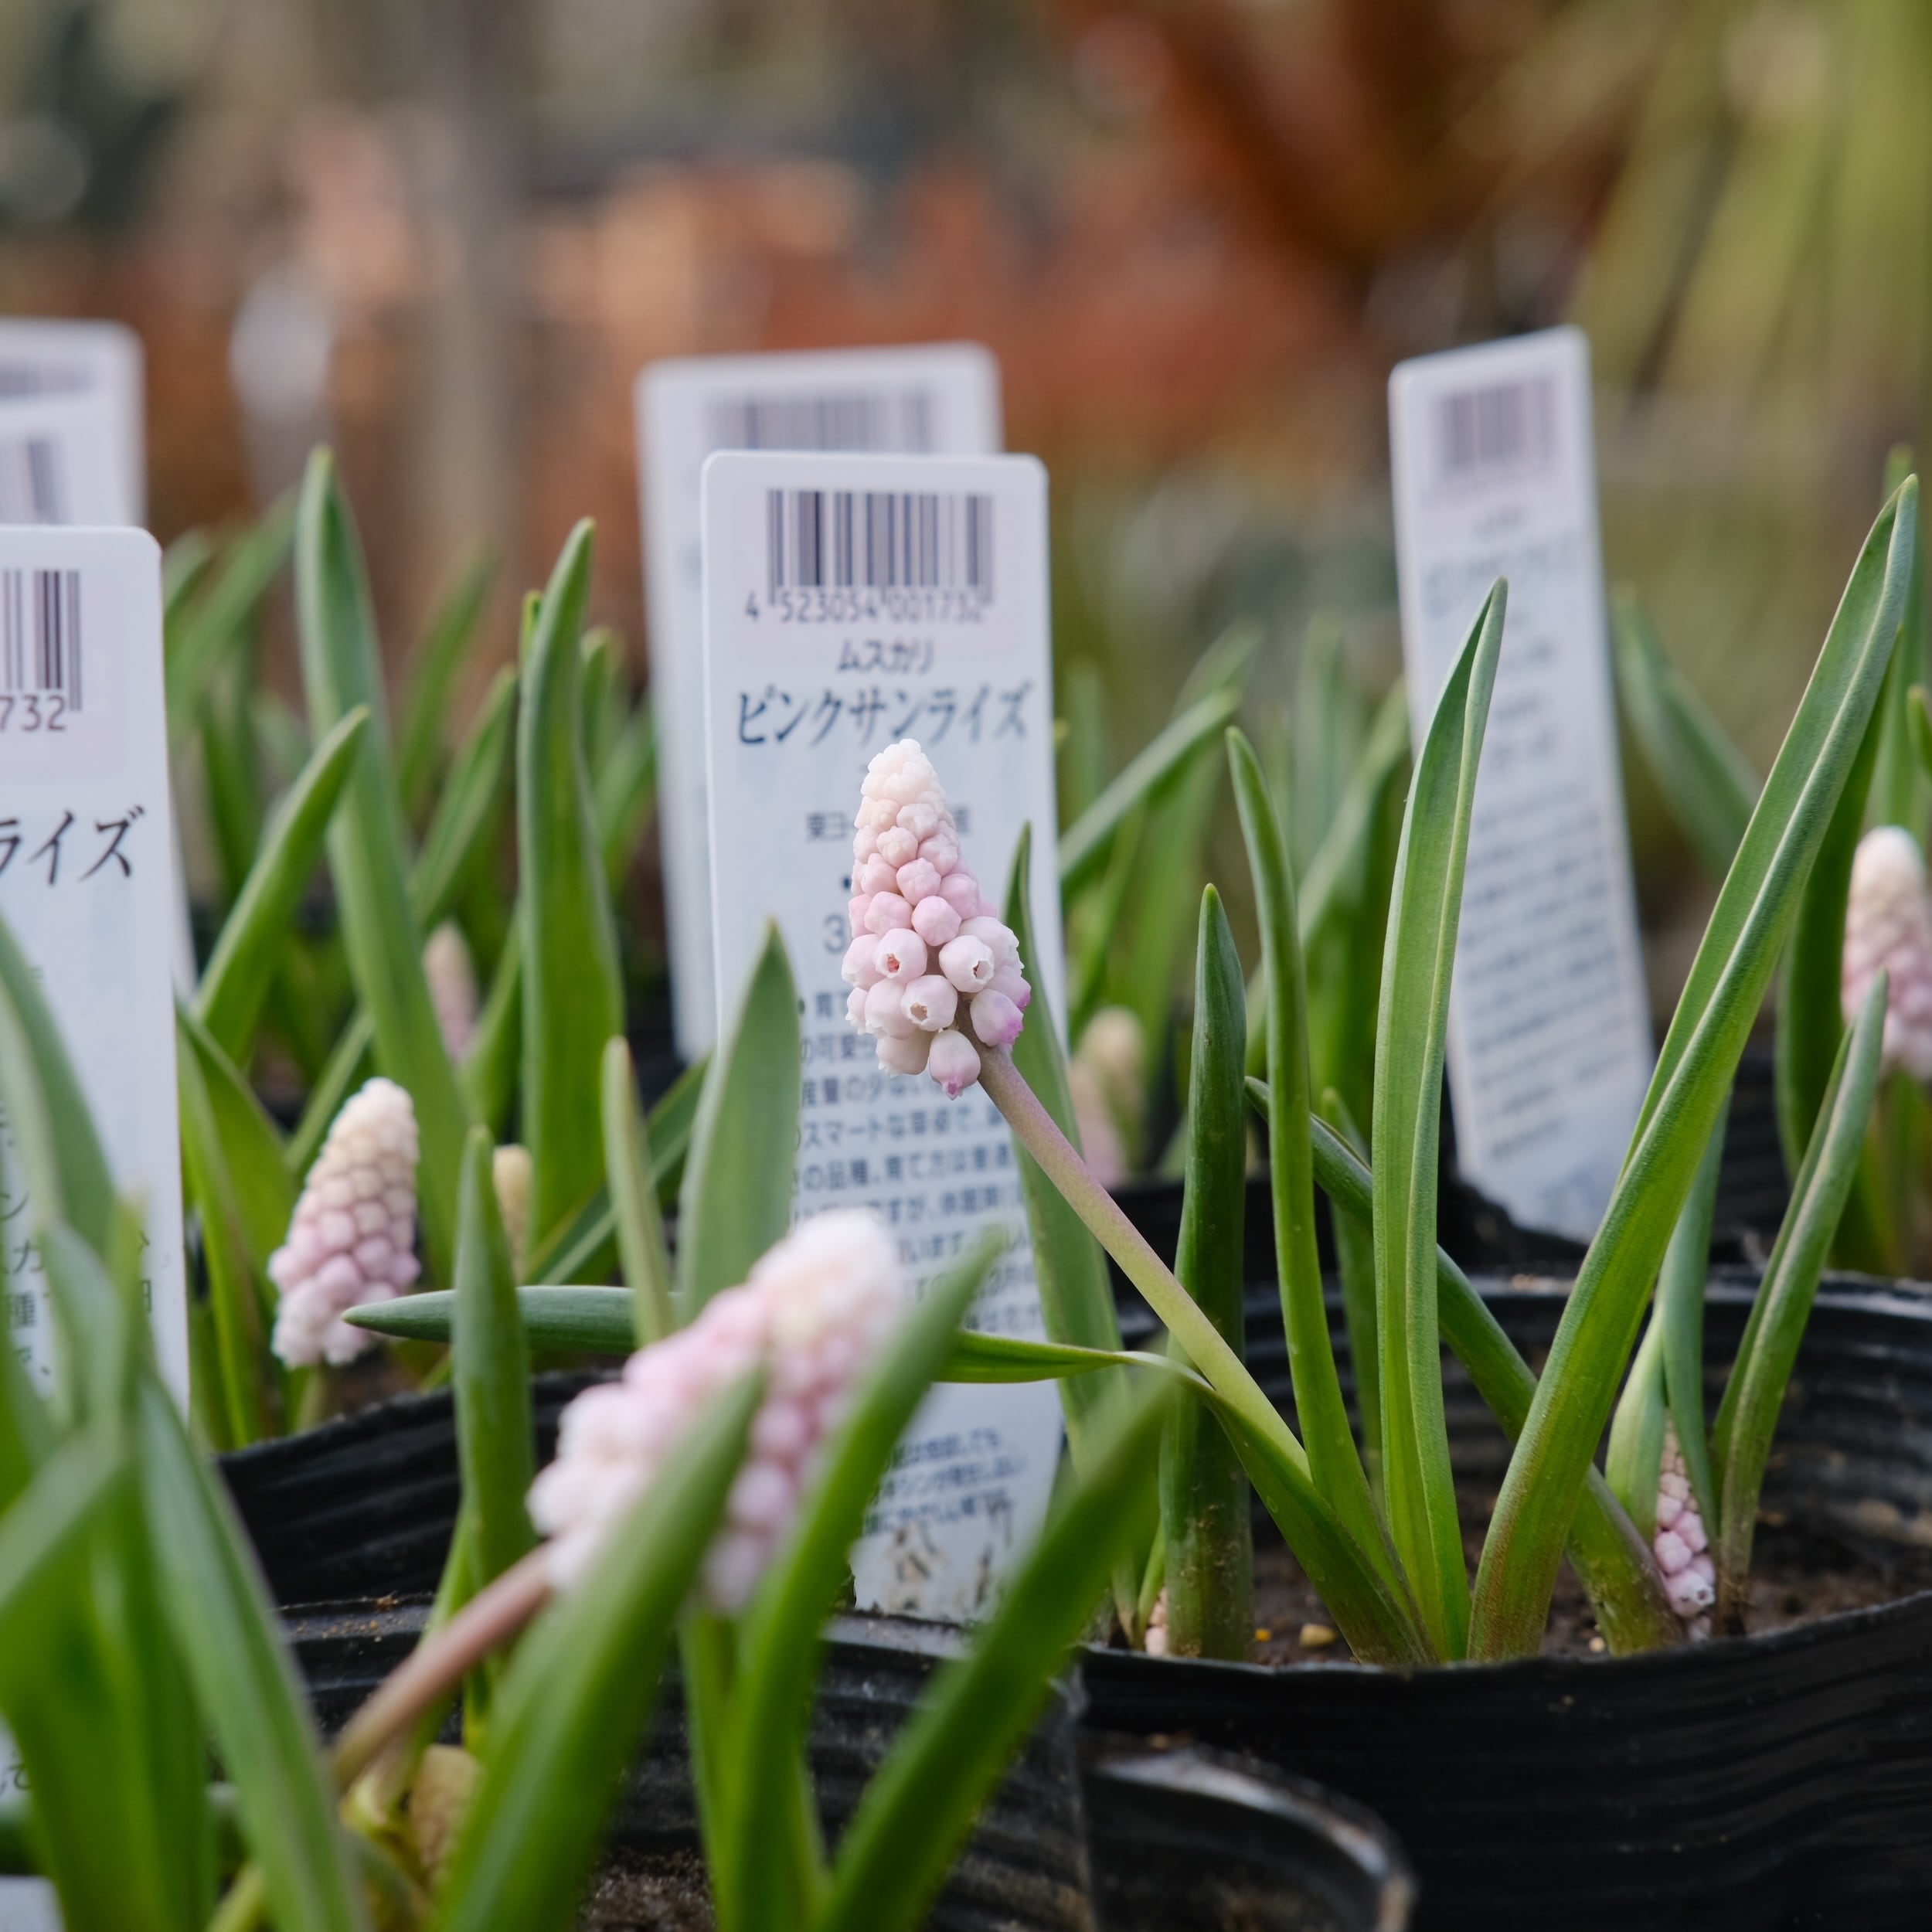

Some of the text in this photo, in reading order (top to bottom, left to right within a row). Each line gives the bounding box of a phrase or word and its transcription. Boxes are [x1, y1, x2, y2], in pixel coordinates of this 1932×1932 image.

[838, 638, 934, 673] ムスカリ
[739, 682, 1032, 747] ピンクサンライズ
